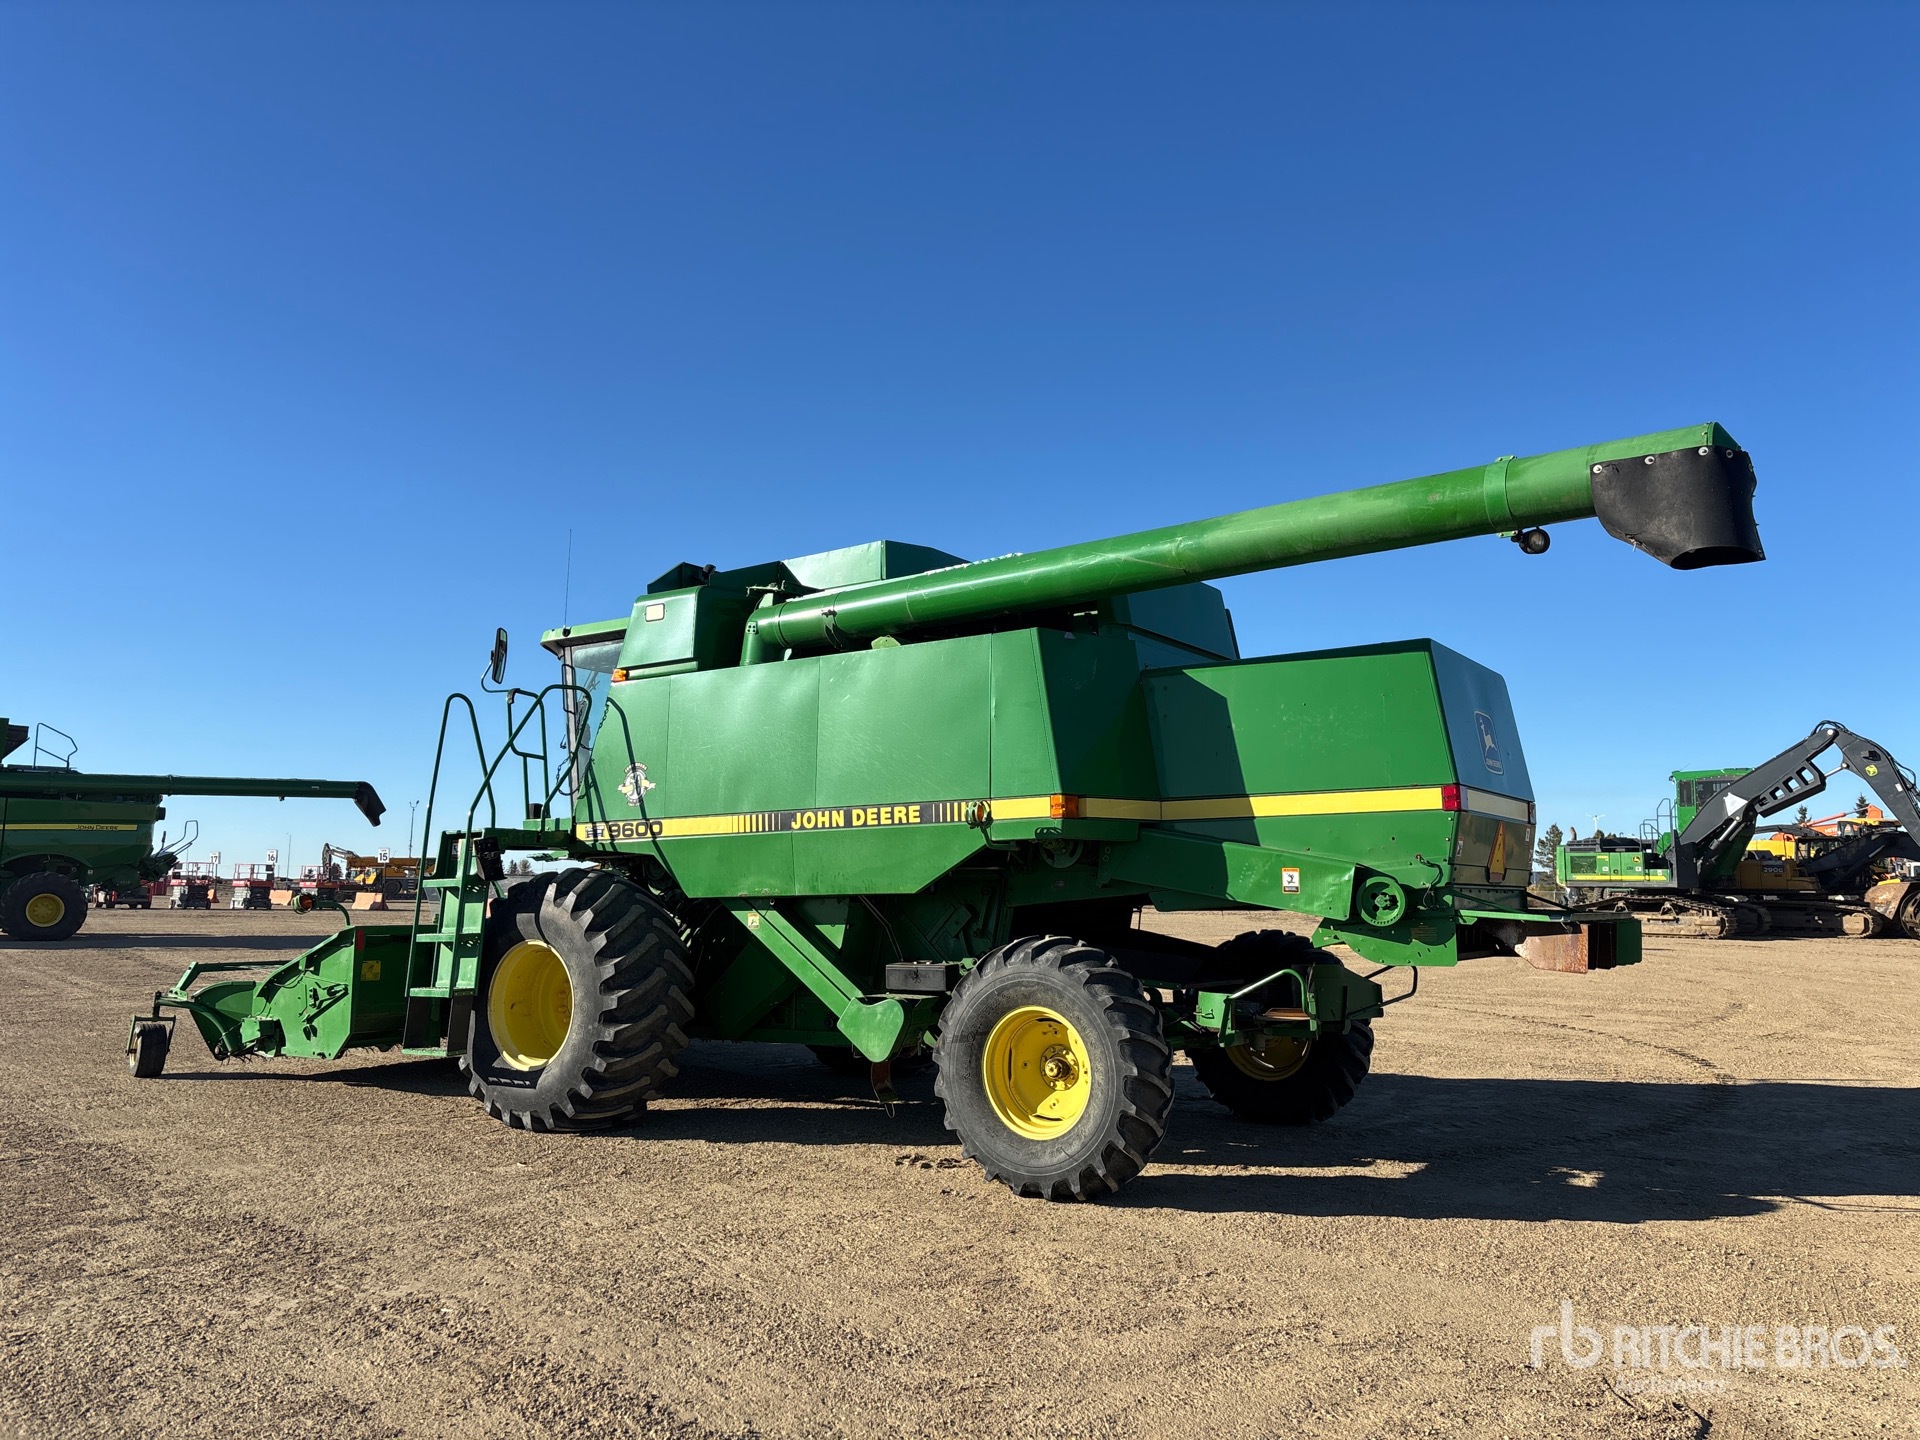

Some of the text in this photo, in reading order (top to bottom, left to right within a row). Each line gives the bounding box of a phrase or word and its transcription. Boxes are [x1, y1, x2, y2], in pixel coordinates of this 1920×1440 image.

[791, 805, 921, 830] JOHN DEERE
[608, 820, 663, 838] 9600
[210, 855, 218, 863] 17
[267, 853, 276, 862] 16
[379, 852, 388, 862] 15
